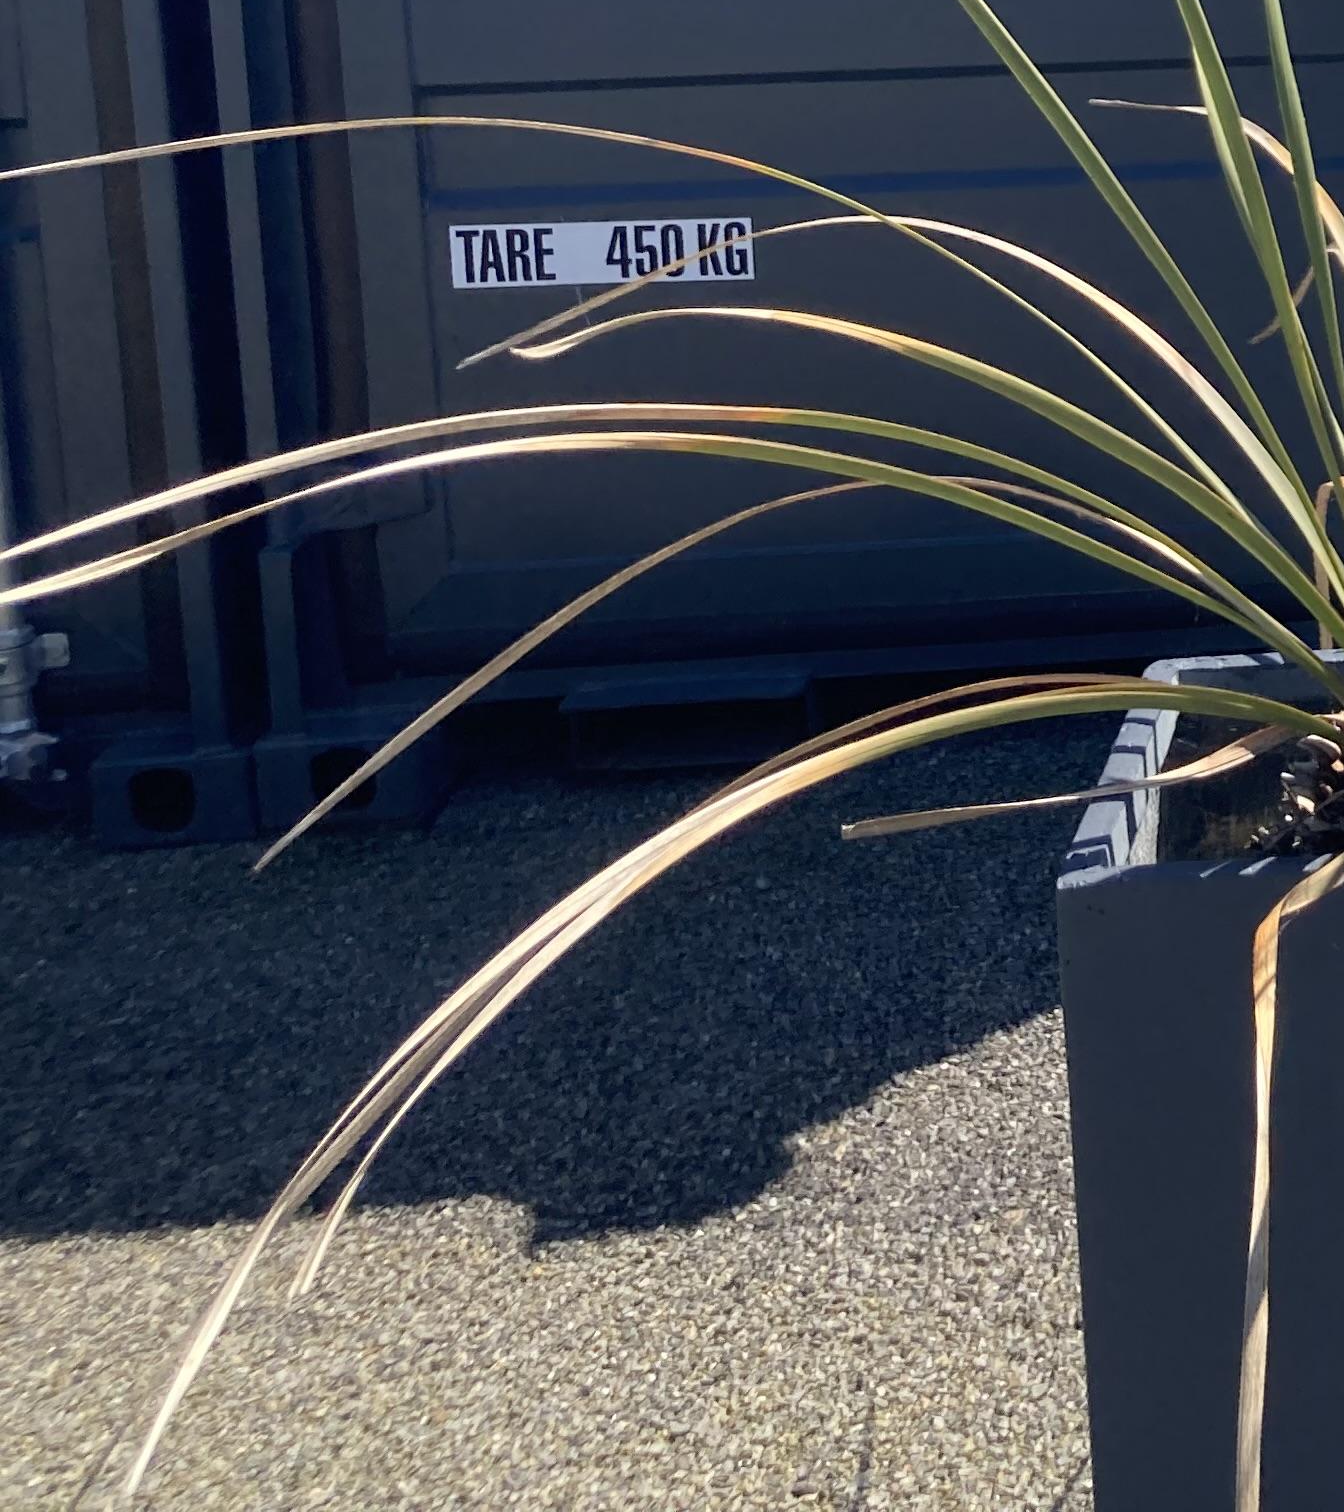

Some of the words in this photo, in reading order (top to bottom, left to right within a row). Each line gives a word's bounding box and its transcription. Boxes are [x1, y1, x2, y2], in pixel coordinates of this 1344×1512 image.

[456, 228, 556, 283] TARE
[606, 224, 685, 278] 450
[697, 221, 749, 276] KG
